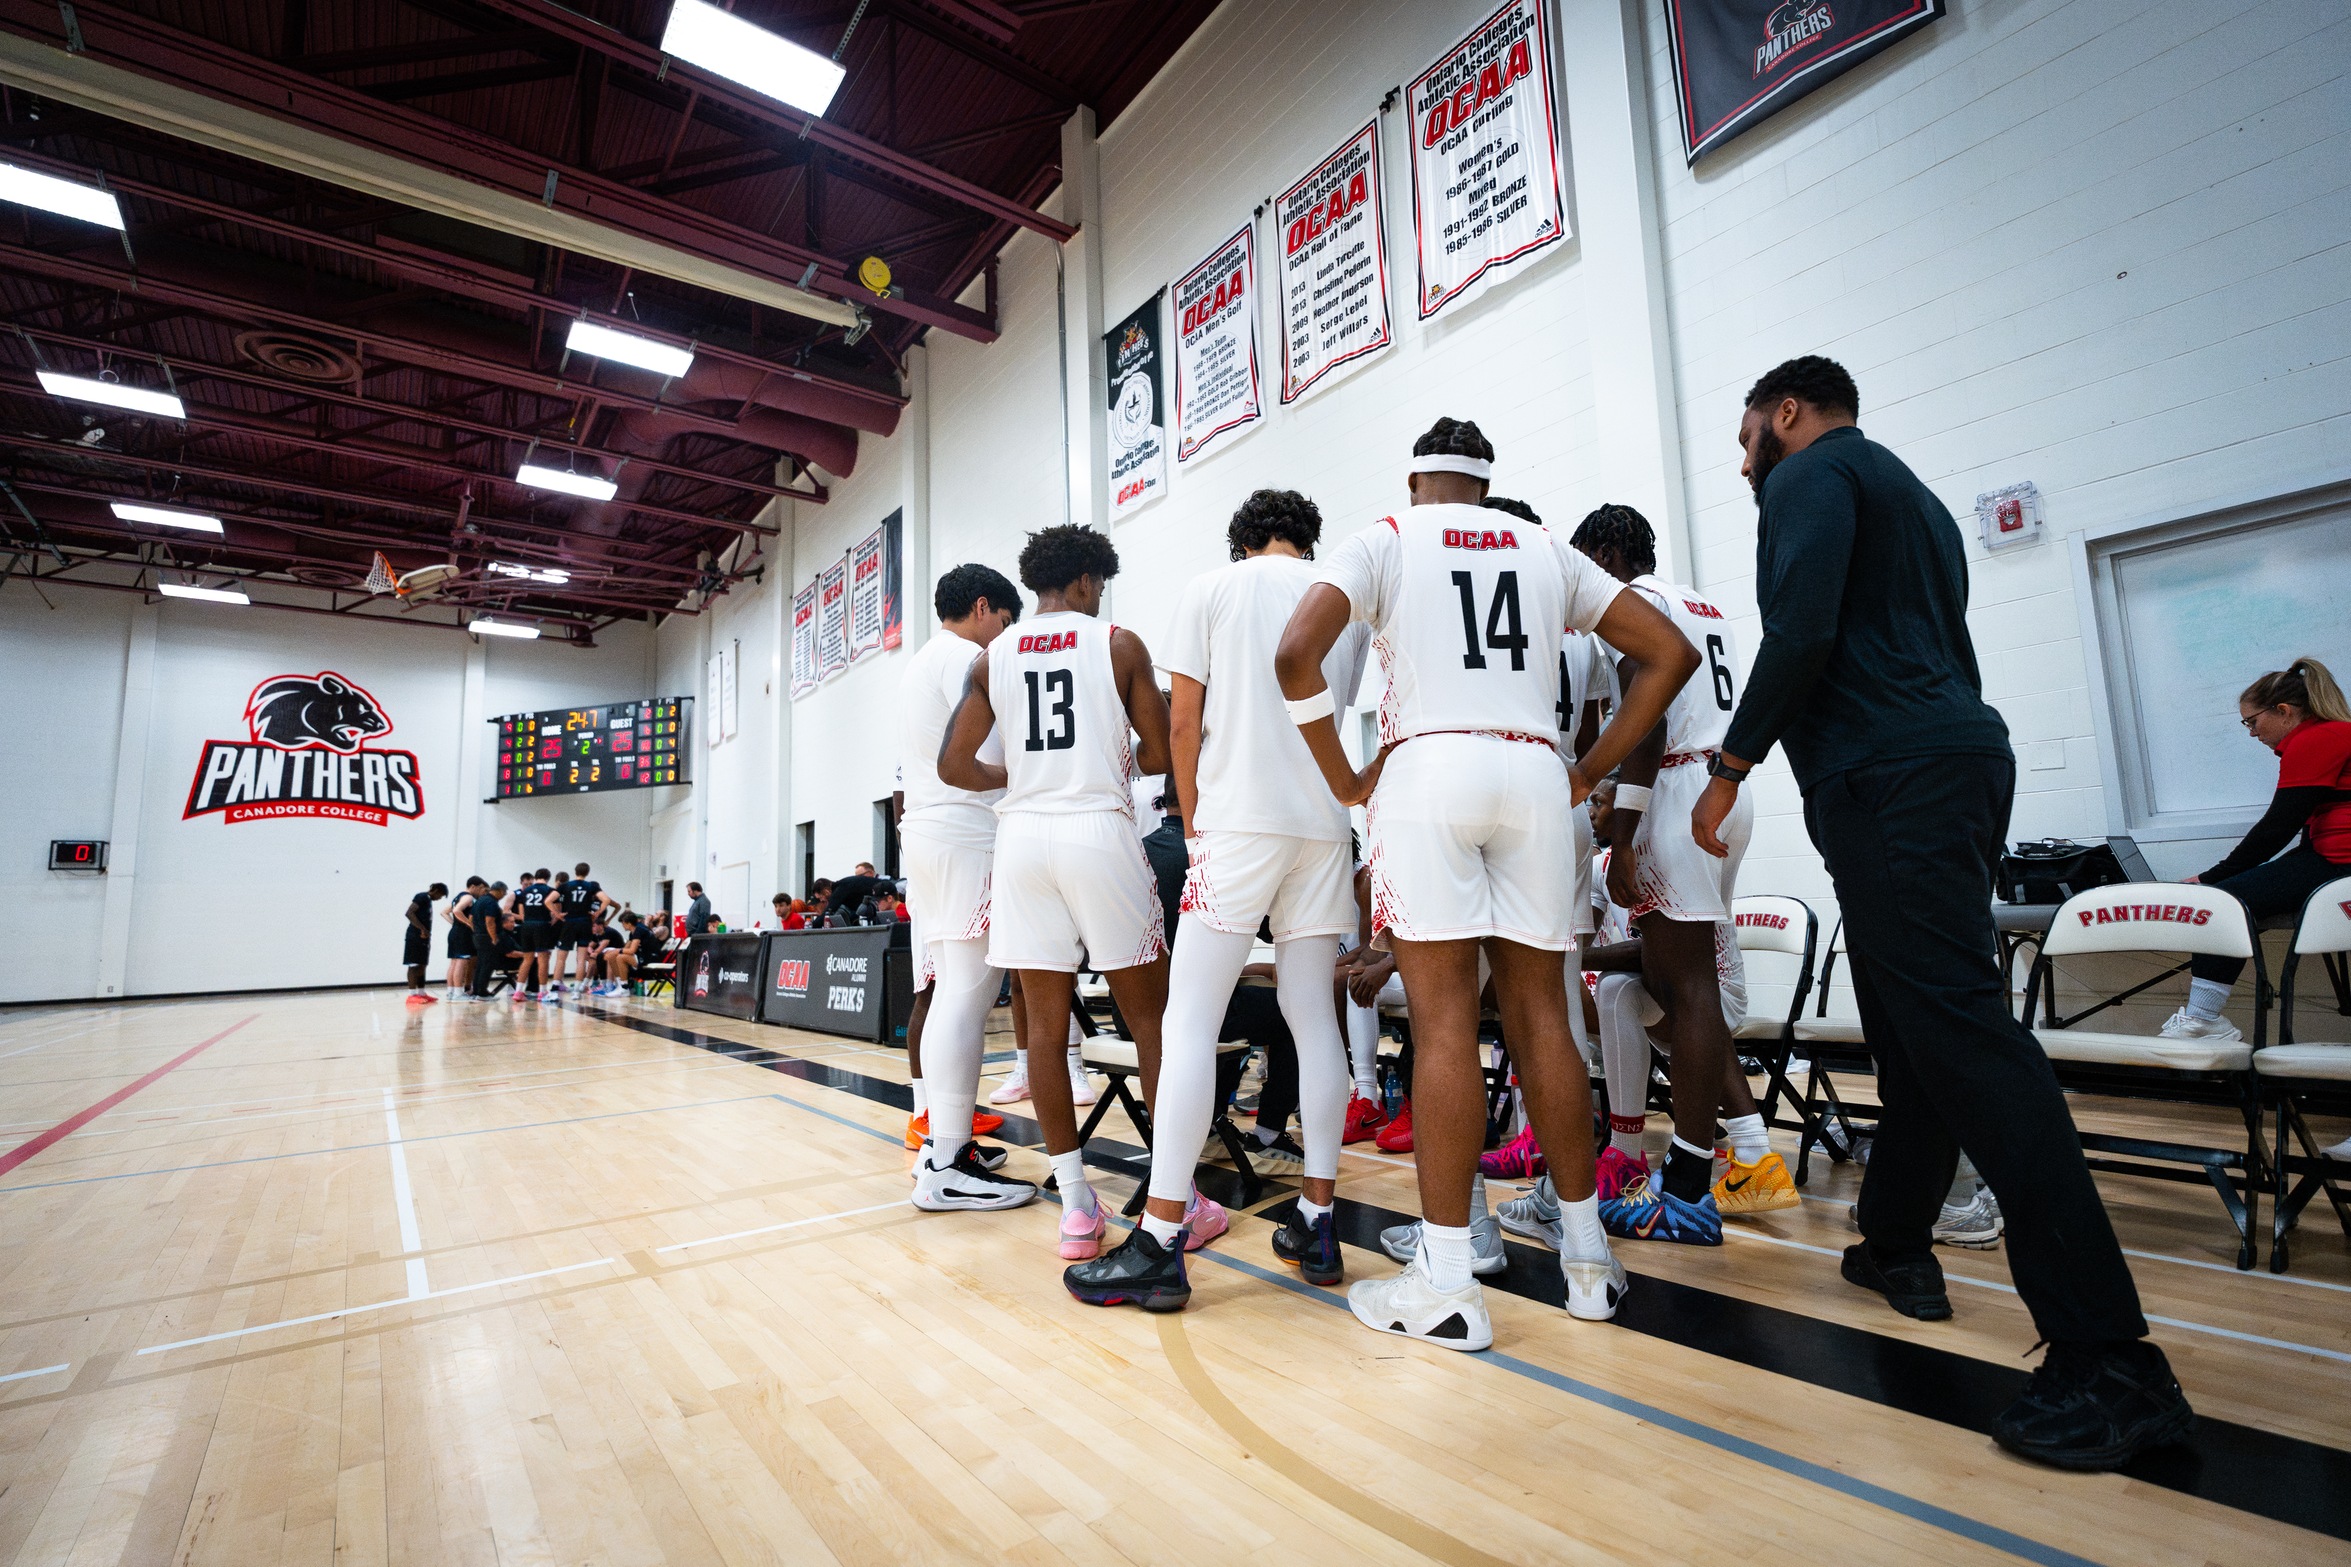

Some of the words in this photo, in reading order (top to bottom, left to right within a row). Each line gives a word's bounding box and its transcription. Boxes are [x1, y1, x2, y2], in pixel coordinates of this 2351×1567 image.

[1426, 52, 1466, 93] Ontario
[1469, 7, 1522, 58] Colleges
[1756, 7, 1832, 74] PANTHERS
[1768, 48, 1794, 70] CANADORE
[1796, 35, 1819, 48] COLLEGE
[1418, 74, 1460, 116] Athletic
[1463, 14, 1535, 81] Association
[1423, 34, 1532, 149] OCAA
[1441, 131, 1468, 155] OCAA
[1473, 95, 1513, 132] Curling
[1459, 138, 1502, 174] Women's
[1288, 178, 1319, 209] Ontario
[1320, 144, 1360, 182] Colleges
[1446, 160, 1492, 200] 1986-1987
[1496, 142, 1519, 168] GOLD
[1283, 196, 1314, 228] Athletic
[1316, 151, 1370, 201] Association
[1469, 177, 1496, 204] Mixed
[1287, 167, 1368, 258] OCAA
[1443, 199, 1488, 238] 1991-1992
[1492, 175, 1527, 206] BRONZE
[1445, 216, 1493, 255] 1985-1986
[1497, 195, 1528, 224] SILVER
[1289, 250, 1310, 272] OCAA
[1312, 237, 1326, 256] Hall
[1329, 228, 1338, 242] of
[1340, 212, 1363, 234] Fame
[1179, 285, 1203, 311] Athletic
[1205, 251, 1246, 291] Association
[1184, 271, 1207, 295] Ontario
[1208, 245, 1240, 276] Colleges
[1291, 282, 1306, 299] 2013
[1313, 275, 1343, 302] Christine
[1344, 256, 1371, 280] Pellerin
[1317, 261, 1334, 281] Linda
[1182, 266, 1245, 338] OCAA
[1292, 299, 1306, 316] 2013
[1313, 295, 1339, 320] Heather
[1341, 273, 1374, 302] Anderson
[1206, 315, 1226, 335] Men's
[1227, 300, 1241, 318] Golf
[1292, 316, 1308, 334] 2009
[1320, 312, 1344, 334] Serge
[1292, 334, 1309, 351] 2003
[1322, 333, 1336, 351] Jeff
[1340, 316, 1368, 340] Willars
[1293, 351, 1310, 368] 2003
[1443, 528, 1520, 550] OCAA
[856, 552, 877, 582] OCAA
[1451, 571, 1528, 671] 14
[1682, 599, 1724, 619] OCAA
[1018, 630, 1078, 654] OCAA
[1706, 634, 1733, 711] 6
[610, 718, 633, 729] GUEST
[657, 707, 663, 718] 0
[669, 706, 676, 716] 2
[1024, 669, 1075, 751] 13
[517, 721, 523, 732] 0
[528, 720, 535, 731] 0
[656, 723, 663, 733] 0
[668, 722, 676, 732] 0
[517, 737, 523, 747] 2
[527, 736, 535, 746] 2
[582, 740, 590, 754] 2
[612, 731, 633, 752] 25
[656, 739, 662, 750] 0
[668, 738, 675, 748] 4
[516, 753, 522, 763] 0
[527, 751, 534, 762] 2
[656, 755, 662, 766] 0
[668, 754, 675, 765] 2
[196, 746, 417, 814] PANTHERS
[527, 767, 534, 778] 0
[542, 771, 551, 785] 0
[570, 768, 578, 784] 2
[590, 766, 600, 781] 2
[621, 764, 630, 779] 0
[655, 771, 661, 782] 0
[667, 770, 675, 781] 0
[526, 783, 533, 793] 6
[233, 805, 315, 820] CANADORE
[320, 805, 382, 822] COLLEGE
[75, 845, 89, 861] 0
[526, 893, 543, 906] 22
[571, 890, 587, 902] 17
[1735, 913, 1790, 931] NTHERS
[2077, 904, 2214, 928] PANTHERS
[777, 960, 810, 991] OCAA
[832, 957, 868, 972] CANADORE
[827, 986, 864, 1012] PERKS
